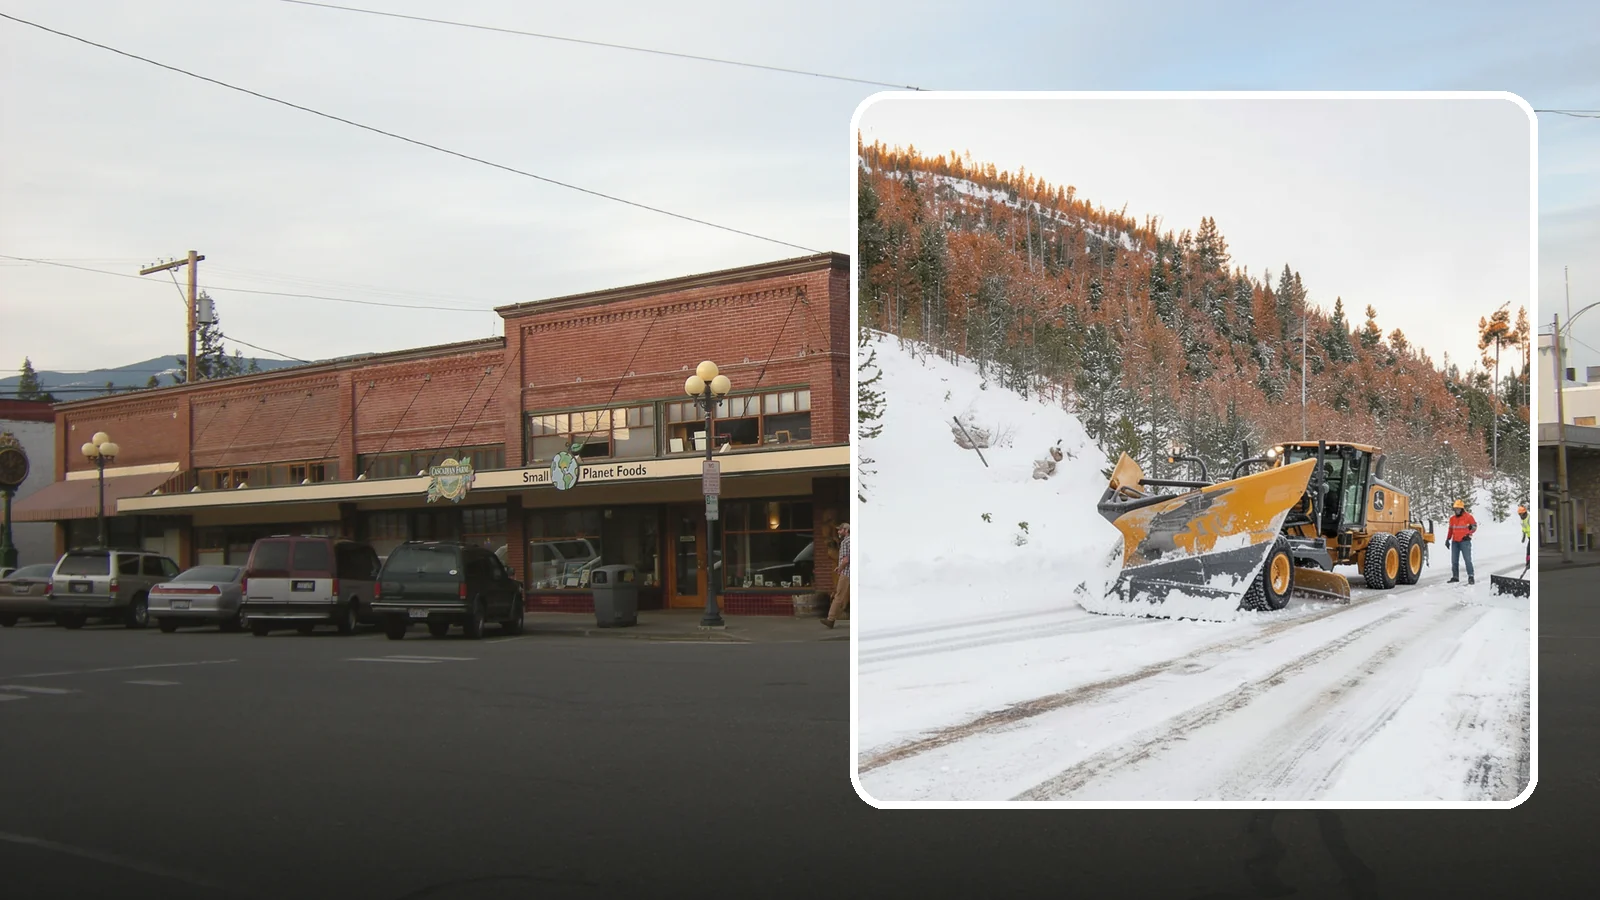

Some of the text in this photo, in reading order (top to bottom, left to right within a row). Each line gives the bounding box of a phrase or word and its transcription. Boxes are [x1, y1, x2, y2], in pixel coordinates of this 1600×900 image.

[523, 464, 647, 483] Small Planet Foods
